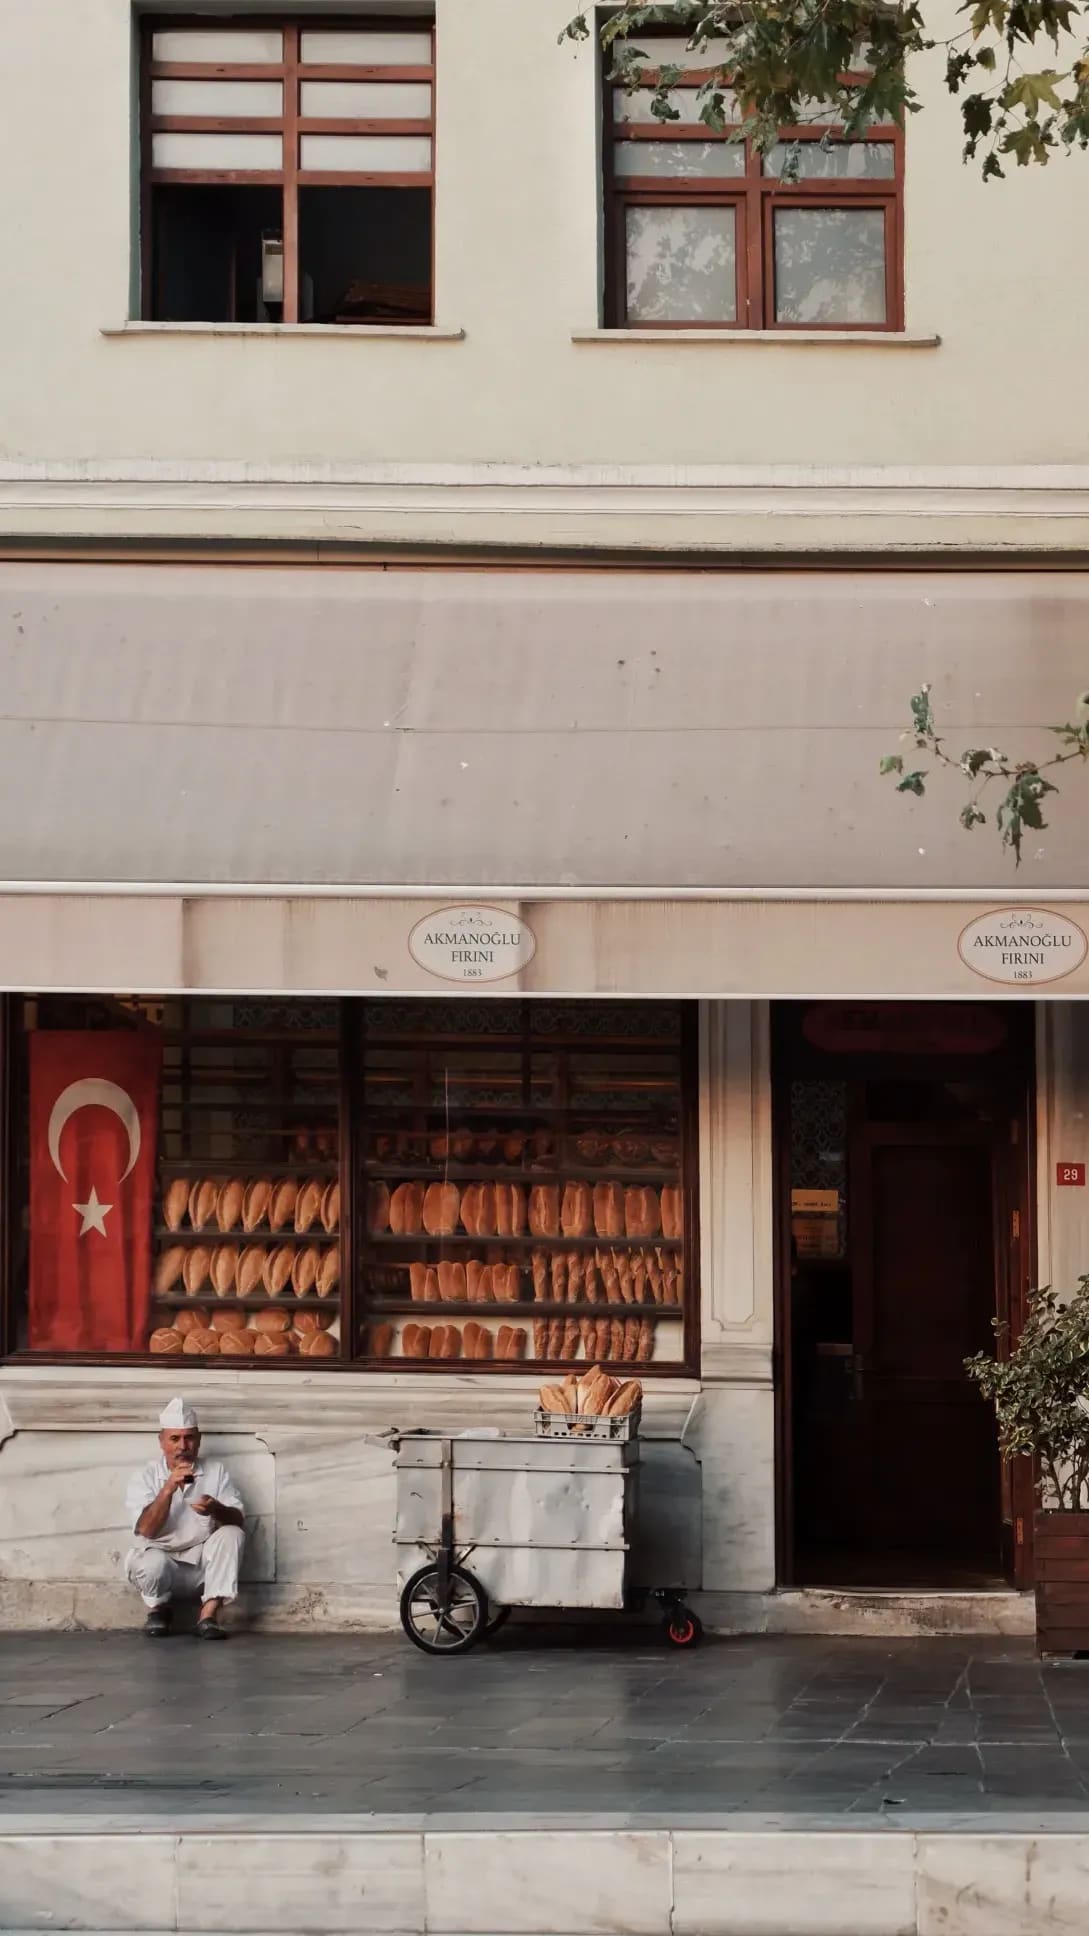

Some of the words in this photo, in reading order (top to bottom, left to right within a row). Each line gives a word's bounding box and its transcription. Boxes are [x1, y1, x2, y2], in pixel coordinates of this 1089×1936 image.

[424, 931, 521, 946] AKMANOĞLU
[973, 933, 1072, 947] AKMANOĞLU
[451, 950, 494, 963] FIRINI
[1002, 952, 1044, 965] FIRINI
[463, 968, 482, 977] 1883
[1013, 970, 1033, 979] 1883
[1063, 1168, 1078, 1181] 29
